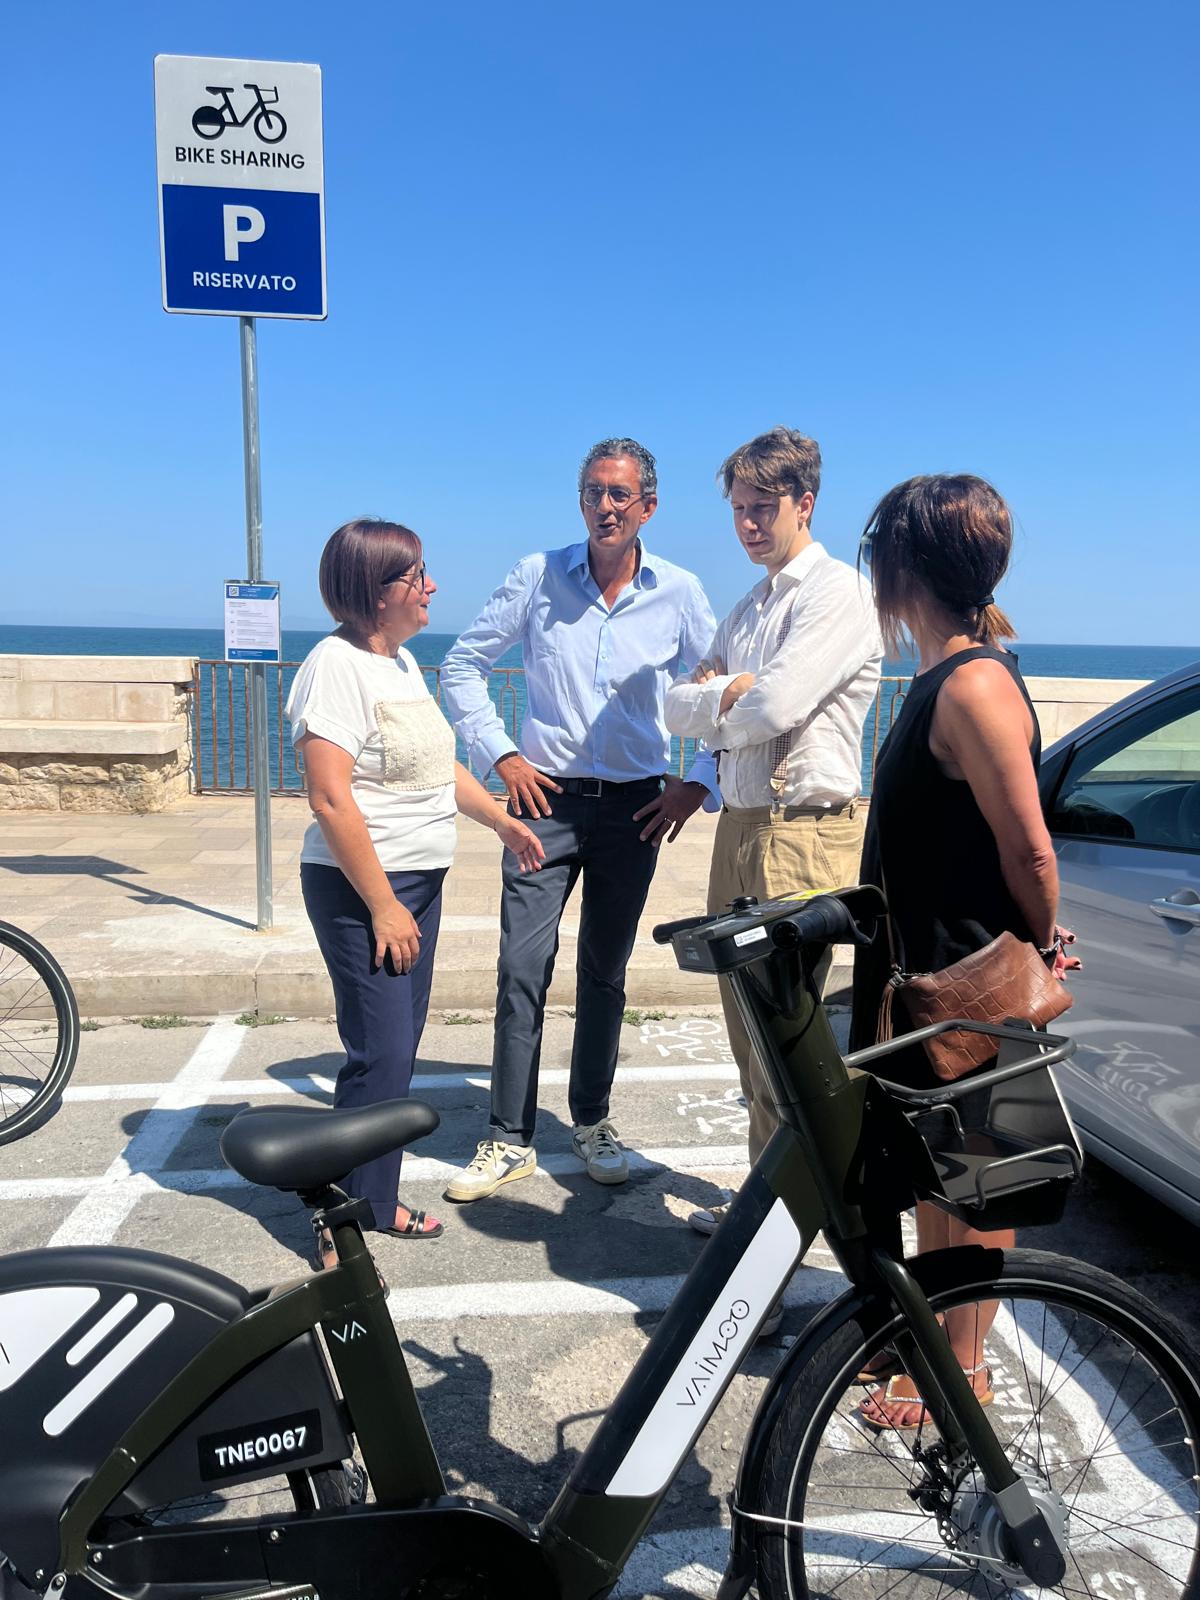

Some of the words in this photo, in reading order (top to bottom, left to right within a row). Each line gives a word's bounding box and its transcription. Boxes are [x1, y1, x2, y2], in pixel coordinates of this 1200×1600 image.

[175, 147, 215, 165] BIKE
[221, 149, 305, 169] SHARING
[223, 204, 266, 262] P
[193, 271, 297, 292] RISERVATO
[331, 1320, 367, 1343] VA
[214, 1426, 307, 1468] TNE0067
